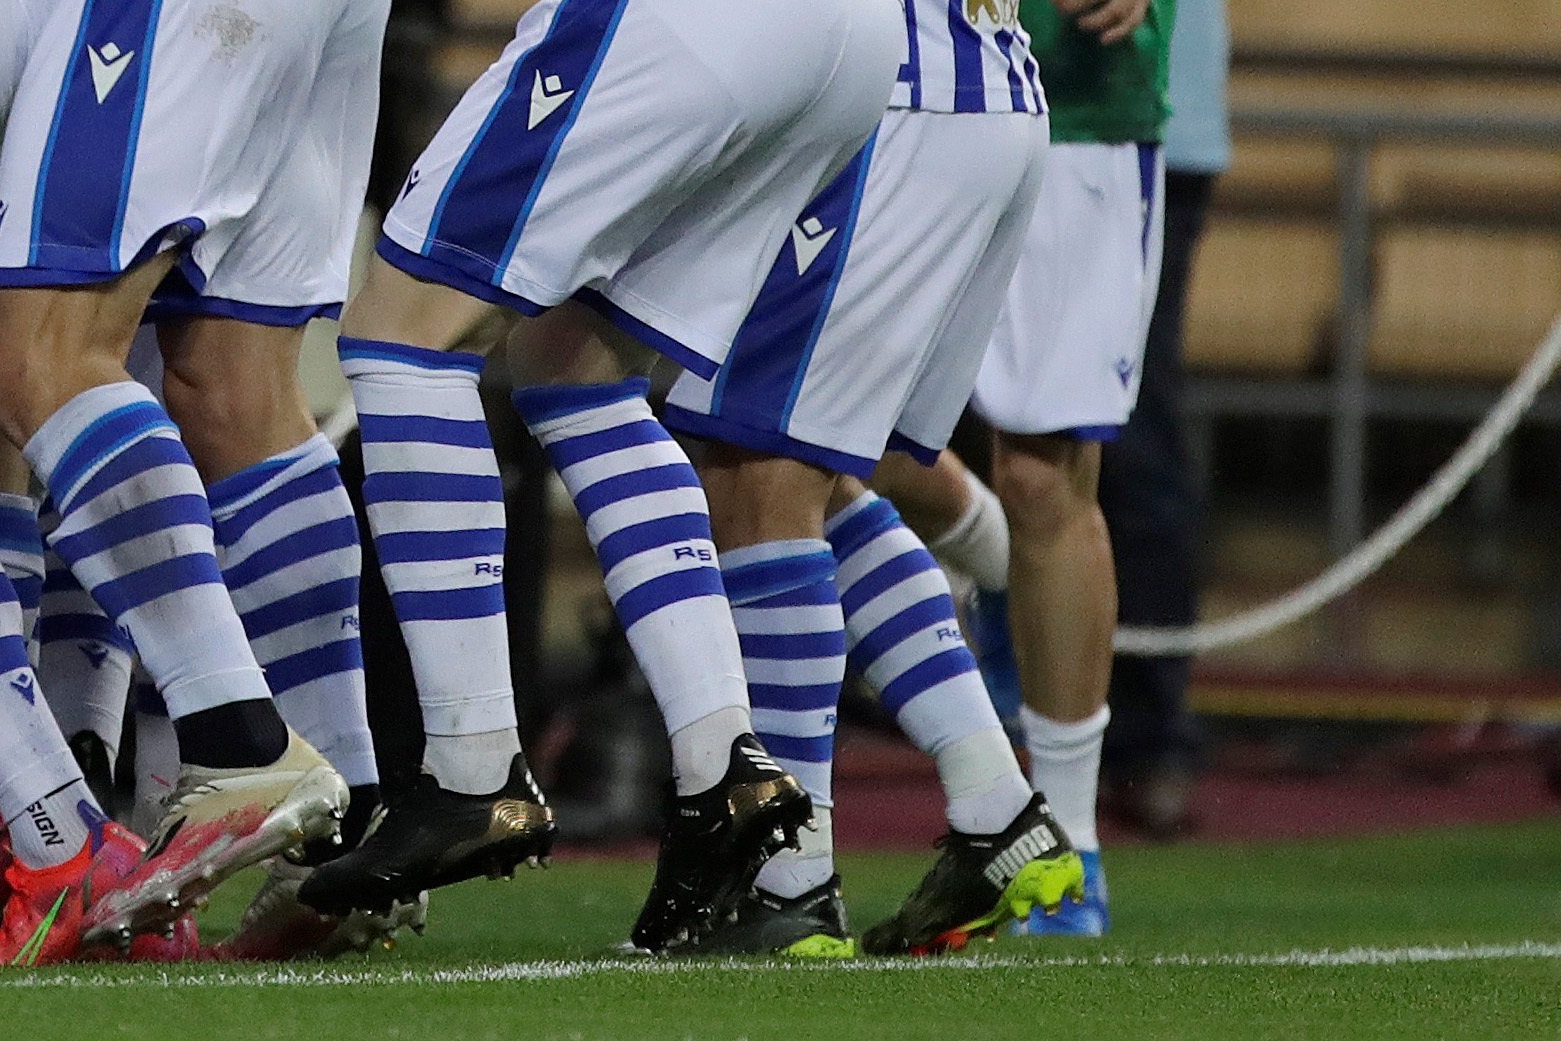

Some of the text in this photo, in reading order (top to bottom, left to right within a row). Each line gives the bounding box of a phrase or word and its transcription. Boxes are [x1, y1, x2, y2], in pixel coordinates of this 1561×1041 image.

[673, 546, 712, 561] RS
[474, 562, 502, 577] RS
[983, 824, 1058, 892] PUMA
